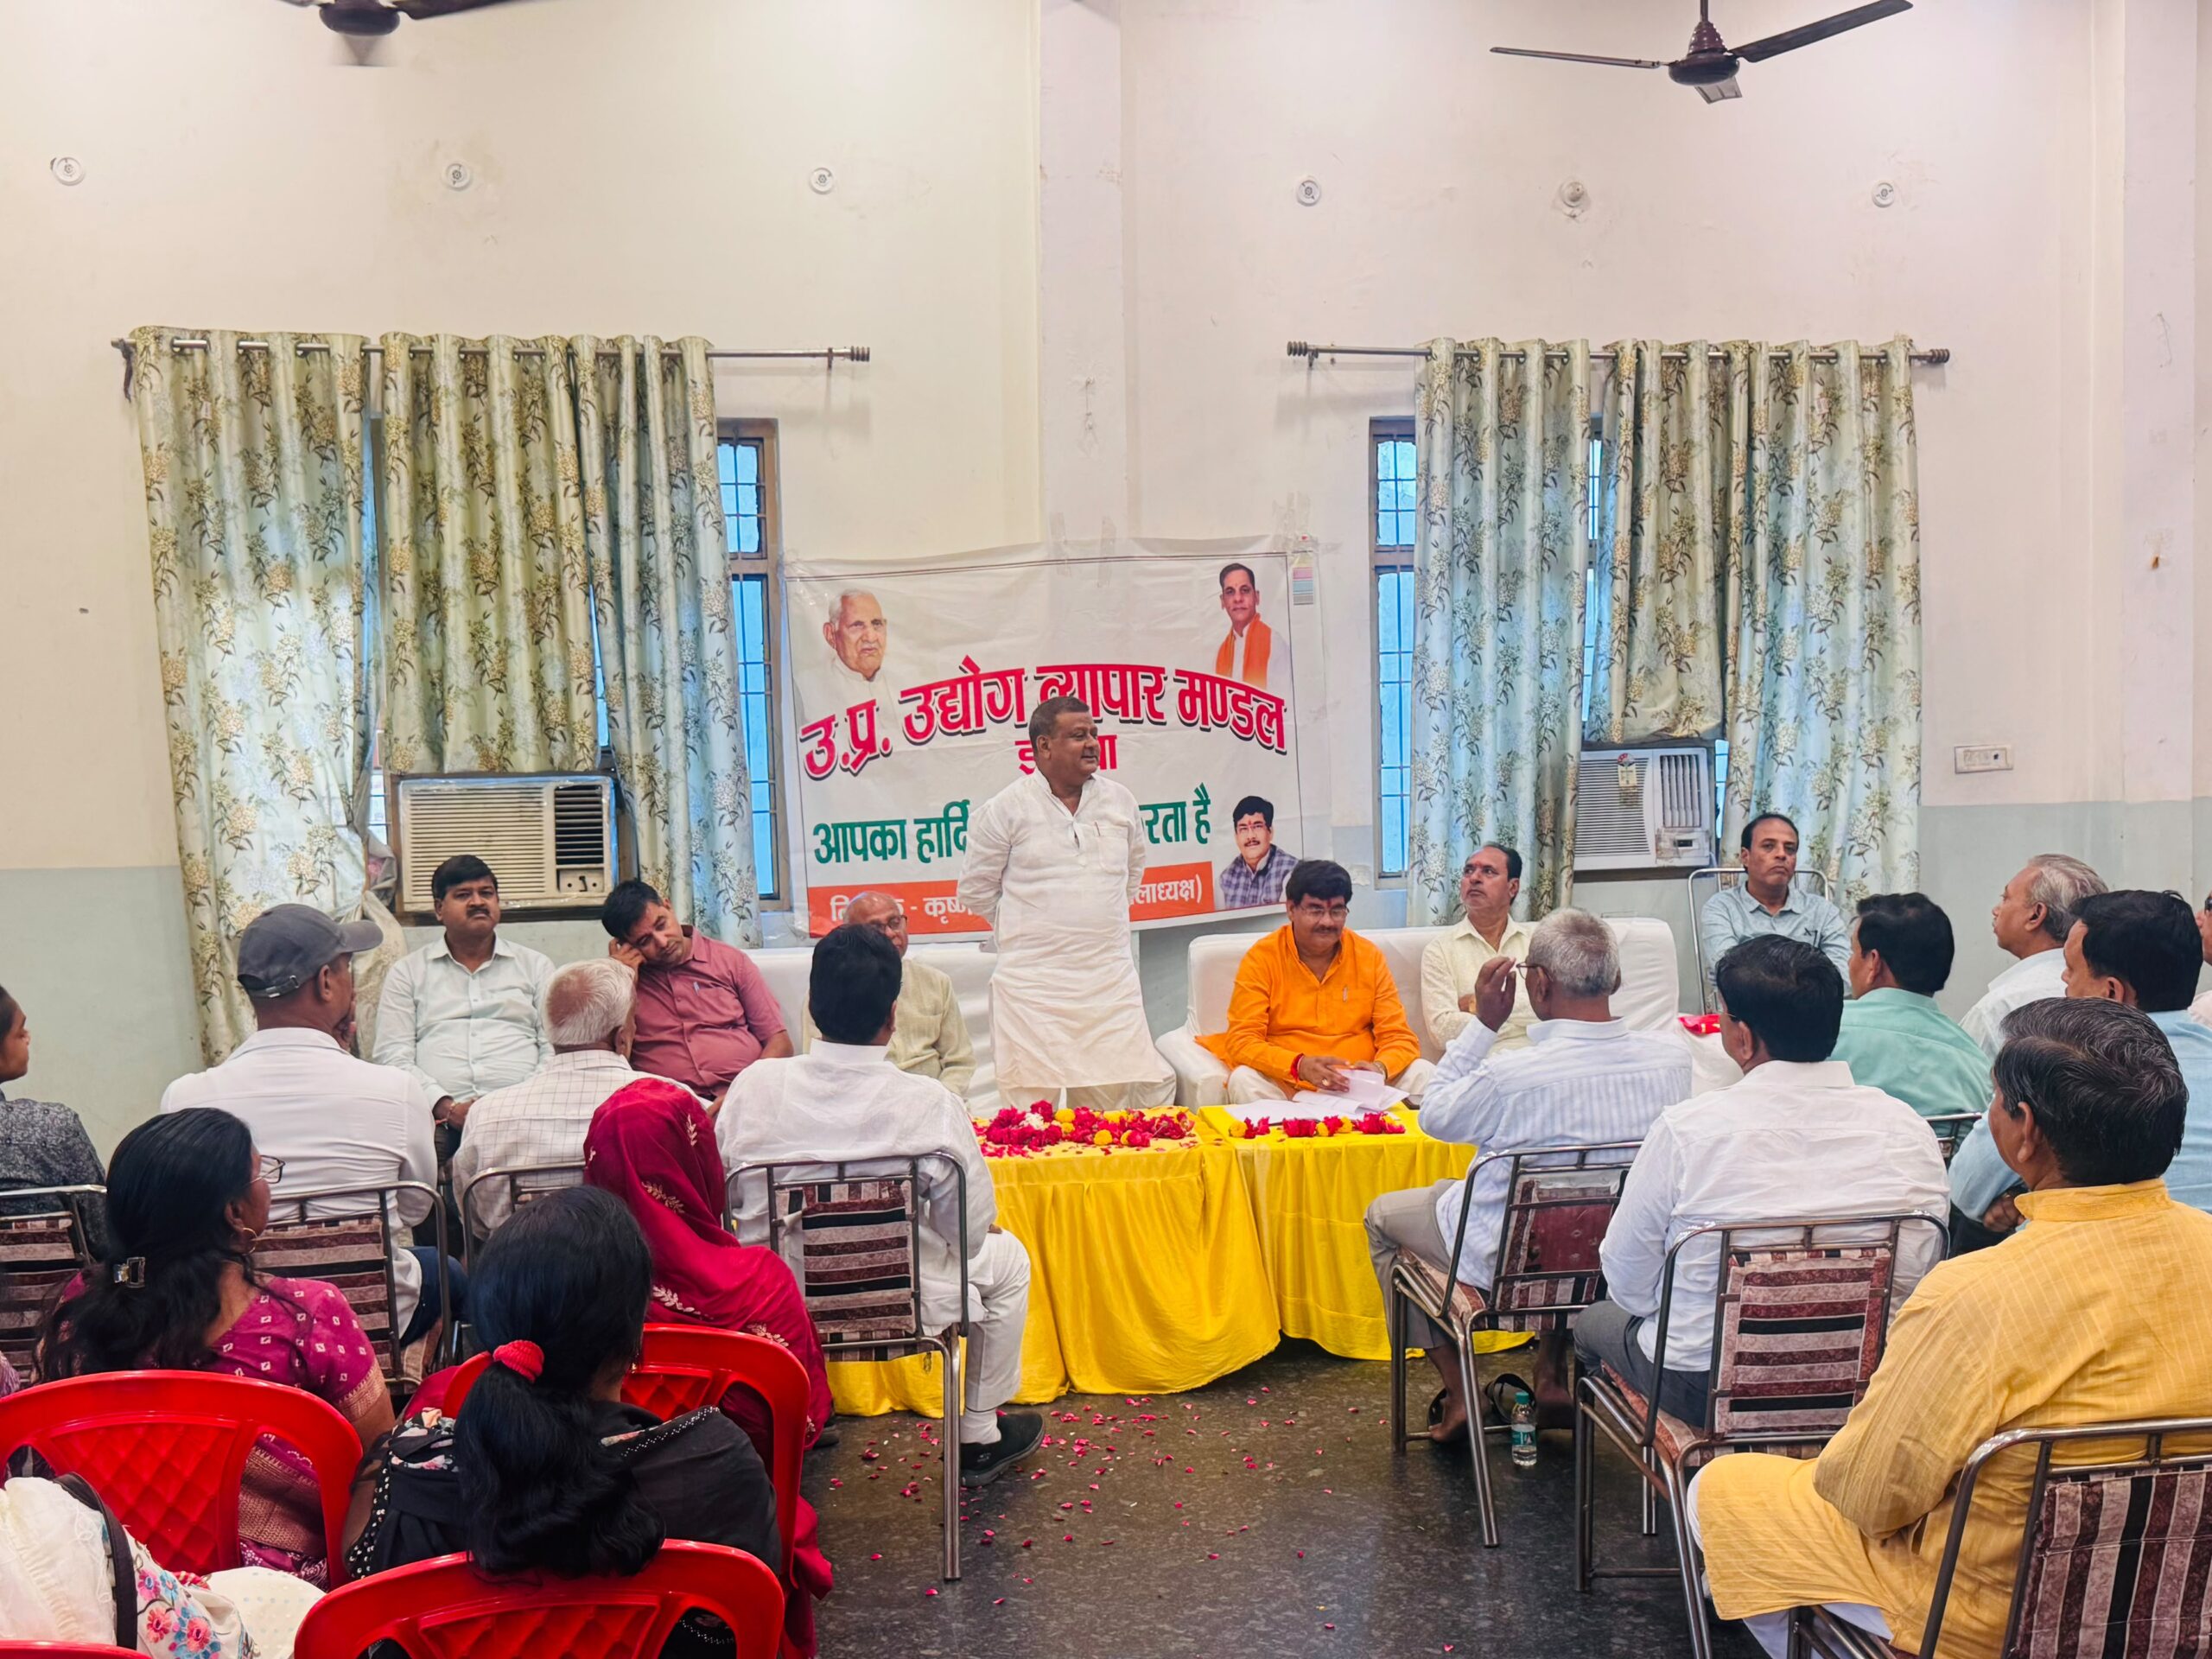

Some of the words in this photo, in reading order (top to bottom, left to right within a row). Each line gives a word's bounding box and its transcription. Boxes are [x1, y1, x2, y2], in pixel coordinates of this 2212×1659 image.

[899, 654, 1027, 745] उद्योग
[1173, 668, 1287, 753] मण्डल
[813, 819, 907, 864] आपका
[1138, 801, 1187, 844] रता
[1192, 782, 1211, 844] है
